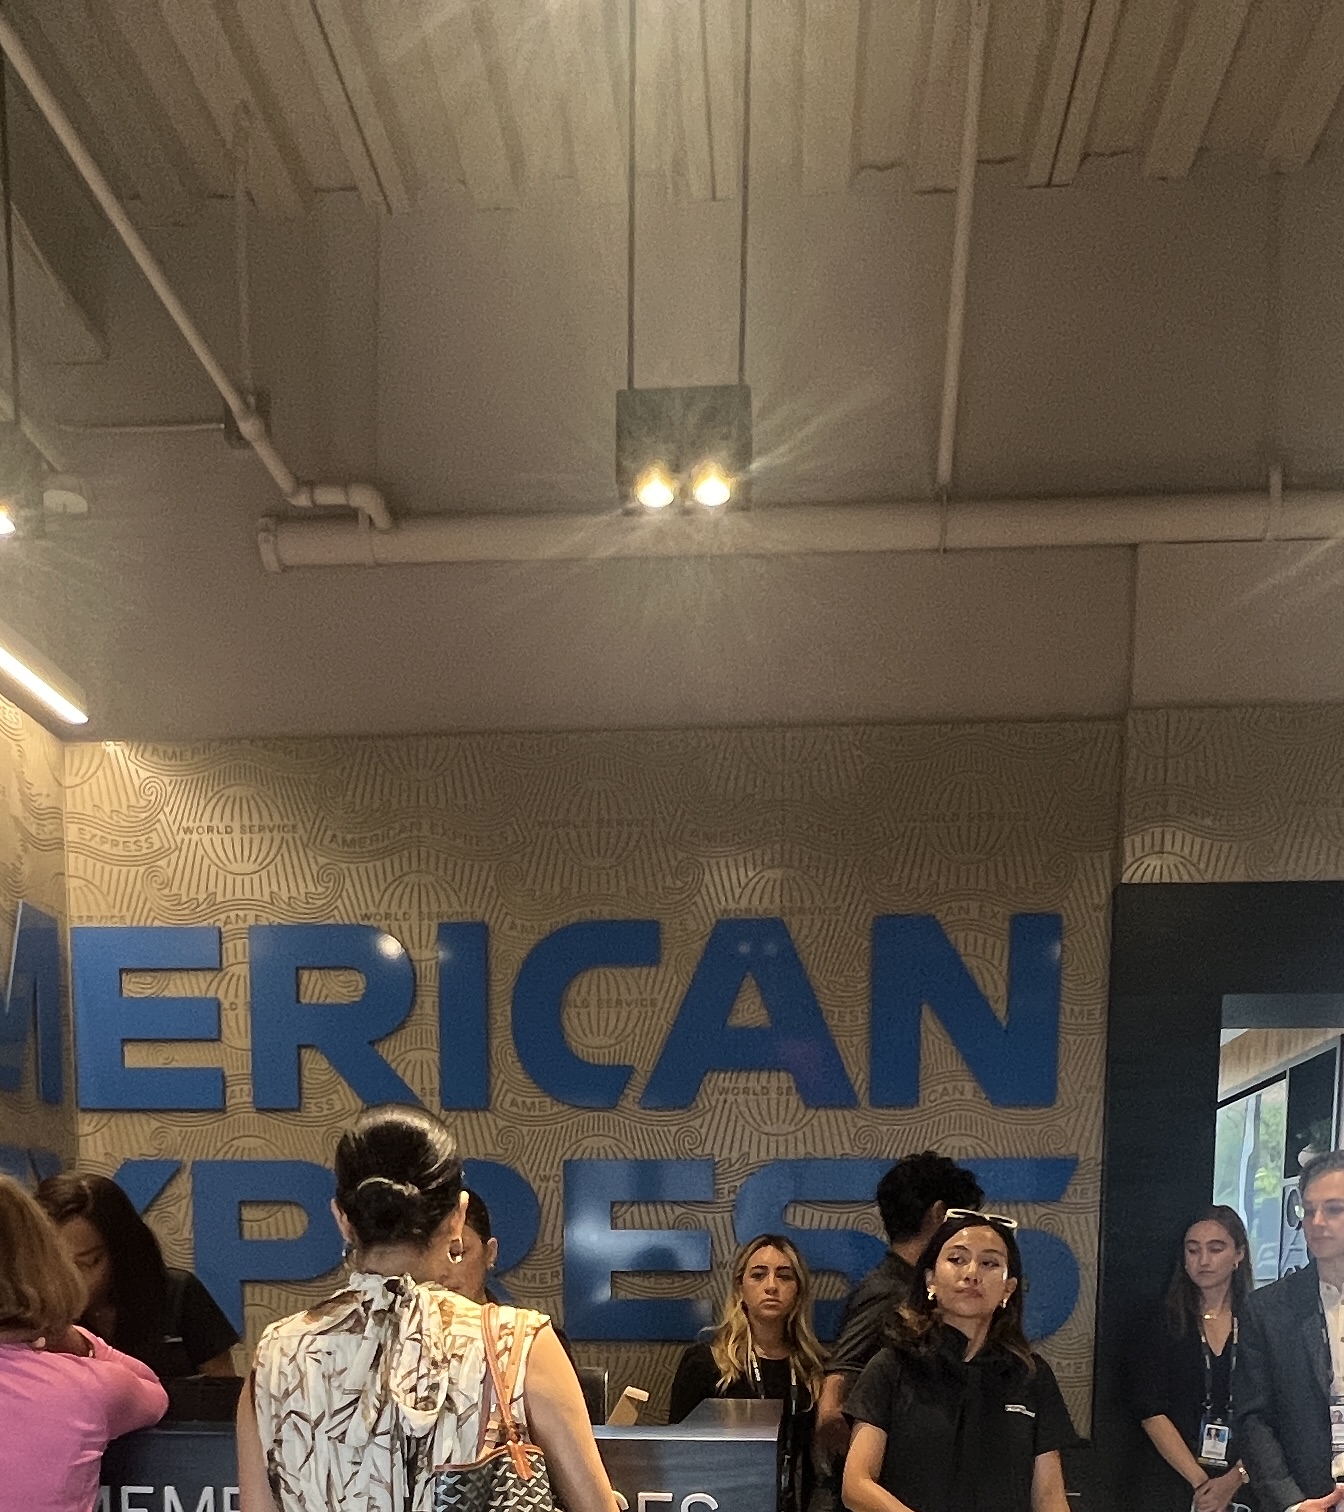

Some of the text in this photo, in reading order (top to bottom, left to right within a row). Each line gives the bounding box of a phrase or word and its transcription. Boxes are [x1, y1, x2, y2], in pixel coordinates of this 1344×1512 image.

[182, 824, 299, 836] WORLD SERVICE
[77, 827, 155, 850] EXPRESS
[360, 911, 412, 922] WORLD
[717, 1085, 769, 1097] WORLD
